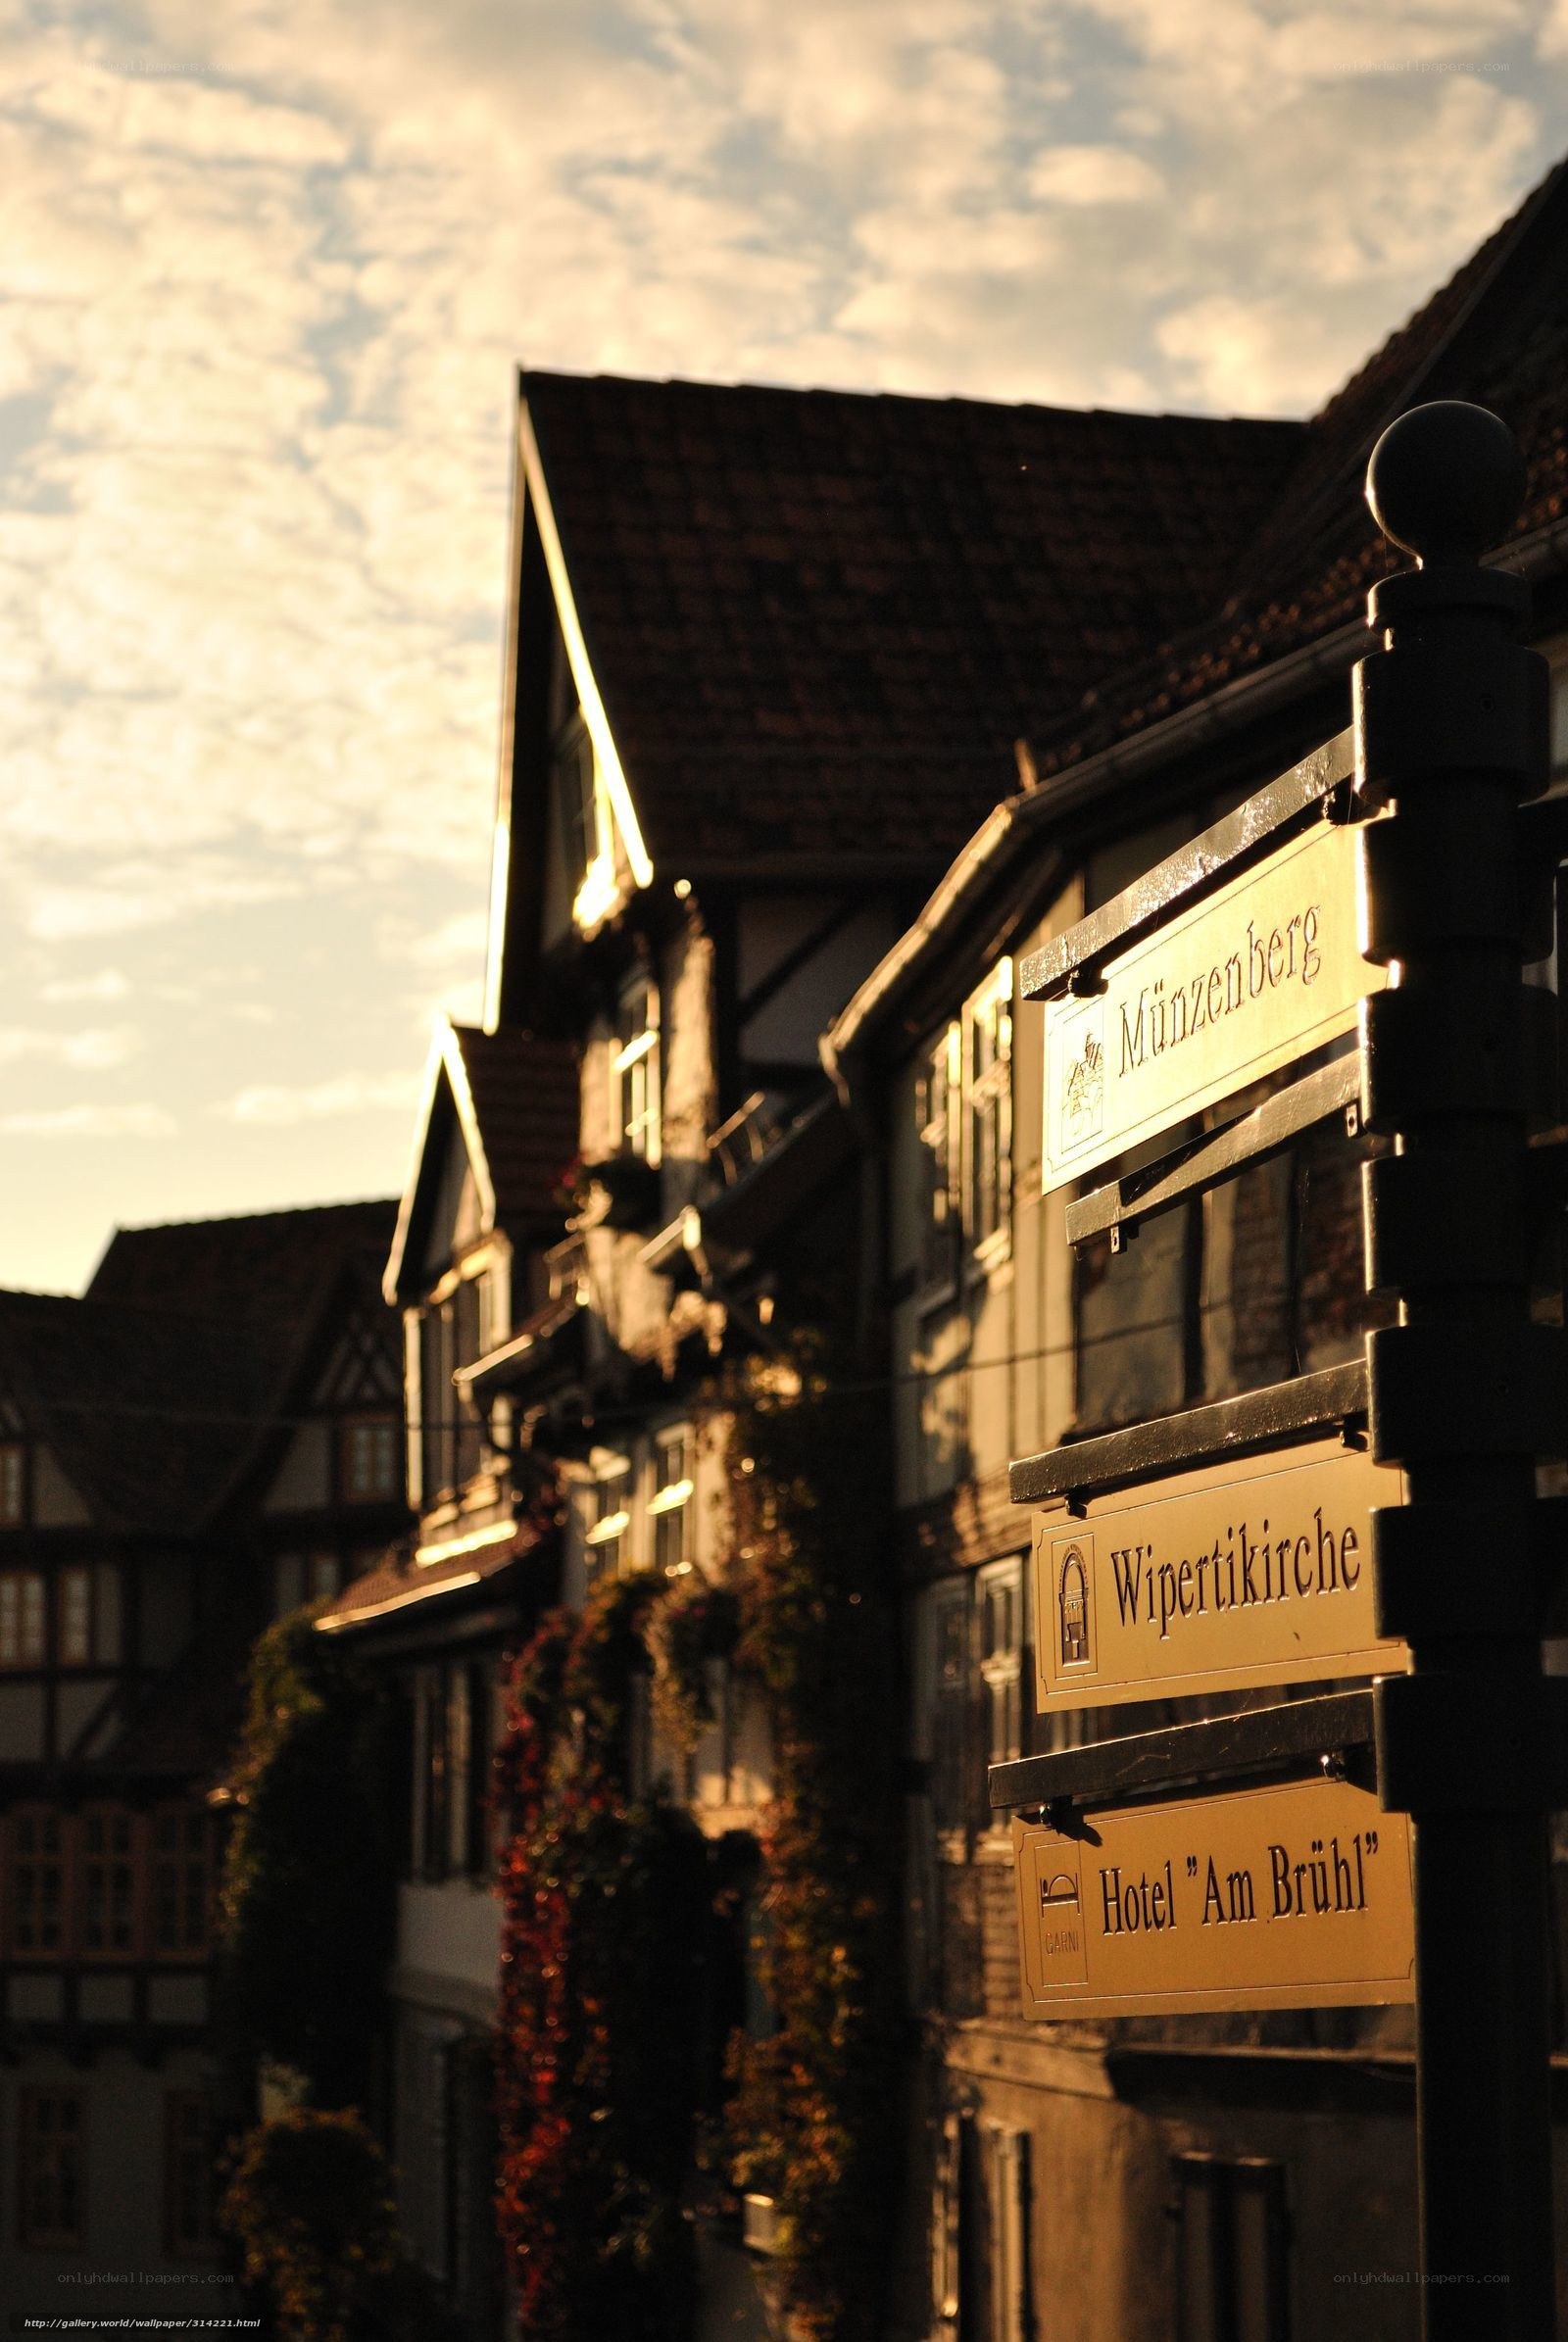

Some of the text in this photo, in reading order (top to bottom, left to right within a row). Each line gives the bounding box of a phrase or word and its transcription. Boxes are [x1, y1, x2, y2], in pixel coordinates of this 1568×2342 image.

[1119, 905, 1321, 1078] Münzenberg
[1110, 1506, 1360, 1640] Wipertikirche
[1045, 1931, 1079, 1956] GARNI
[1100, 1860, 1178, 1936] Hotel
